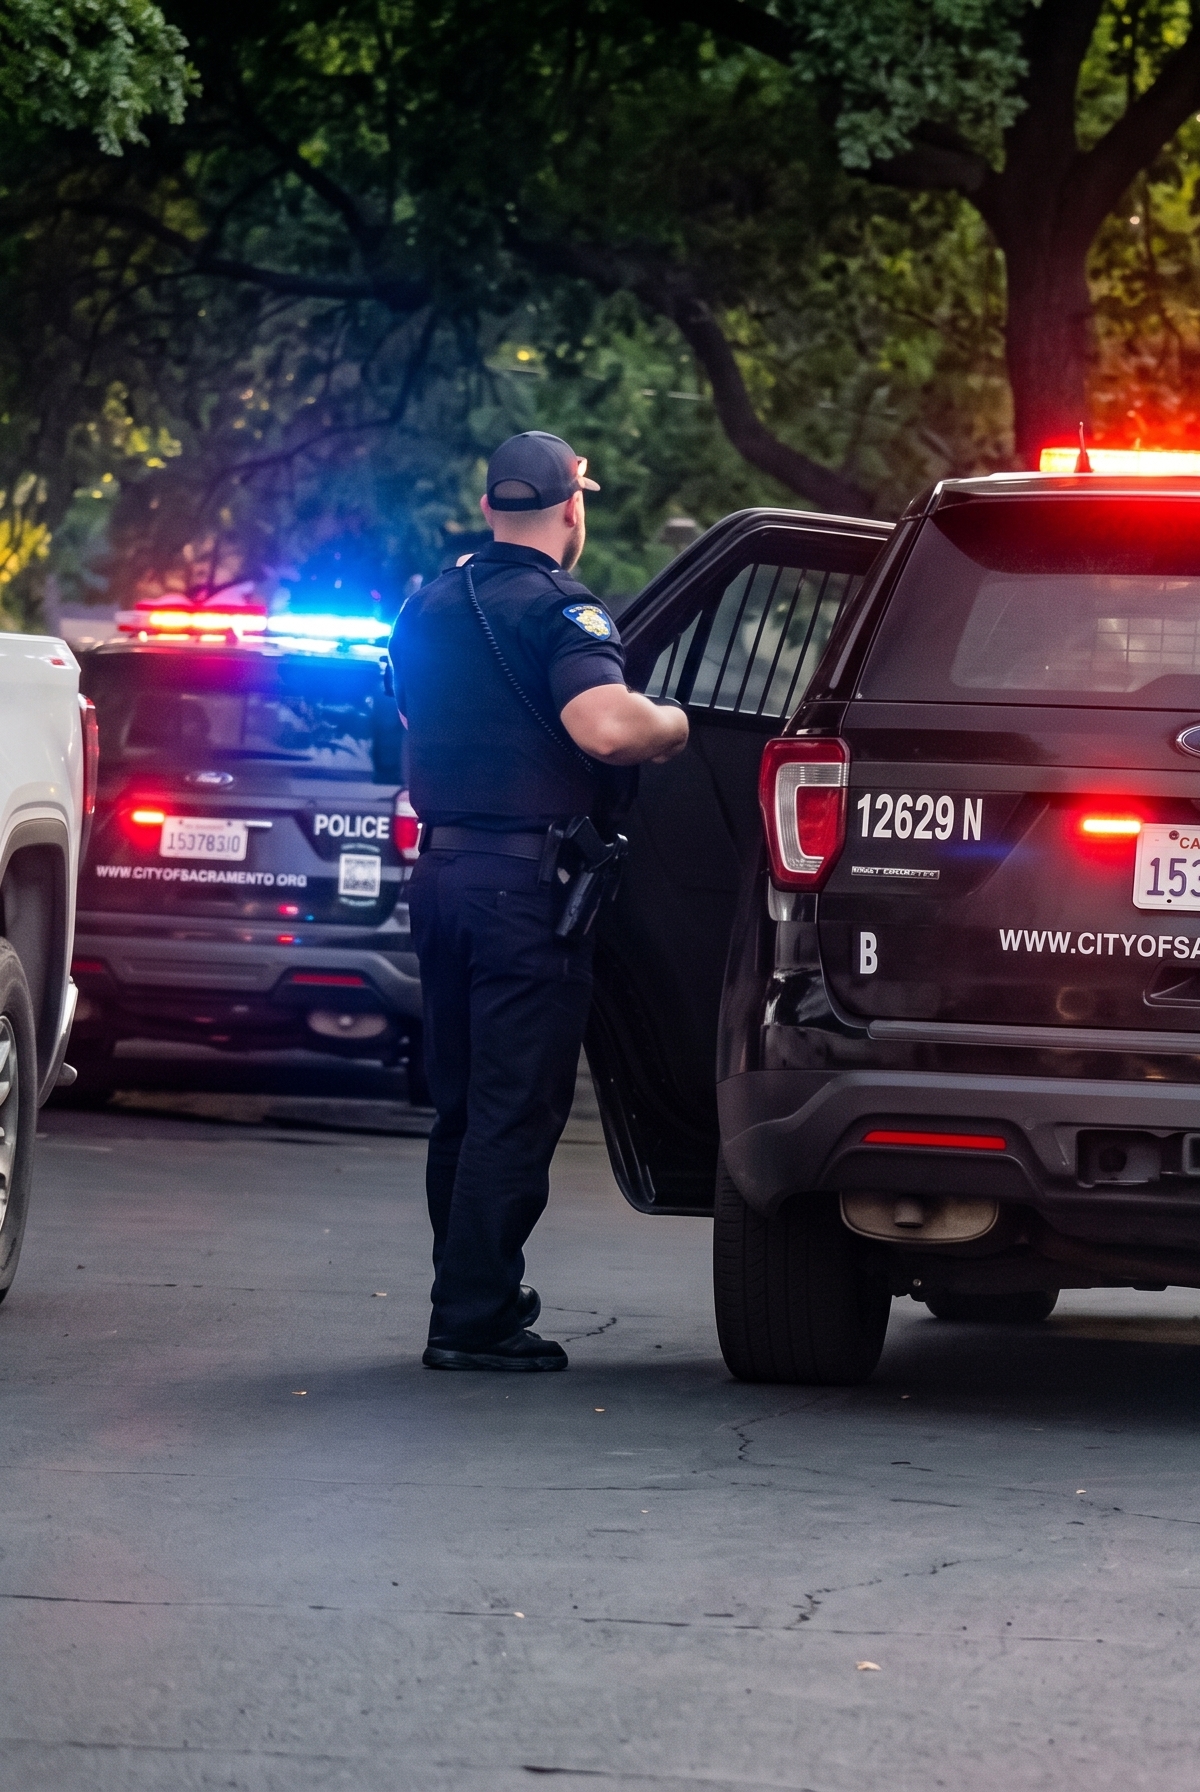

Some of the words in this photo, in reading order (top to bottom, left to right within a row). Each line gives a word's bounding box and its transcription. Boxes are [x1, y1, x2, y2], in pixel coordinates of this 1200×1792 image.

[314, 813, 390, 839] POLICE
[857, 793, 955, 840] 12629
[962, 798, 983, 841] N
[1179, 837, 1200, 850] CA
[96, 864, 307, 888] WWW.CITYOFSACRAMENTOORG
[859, 931, 879, 975] B
